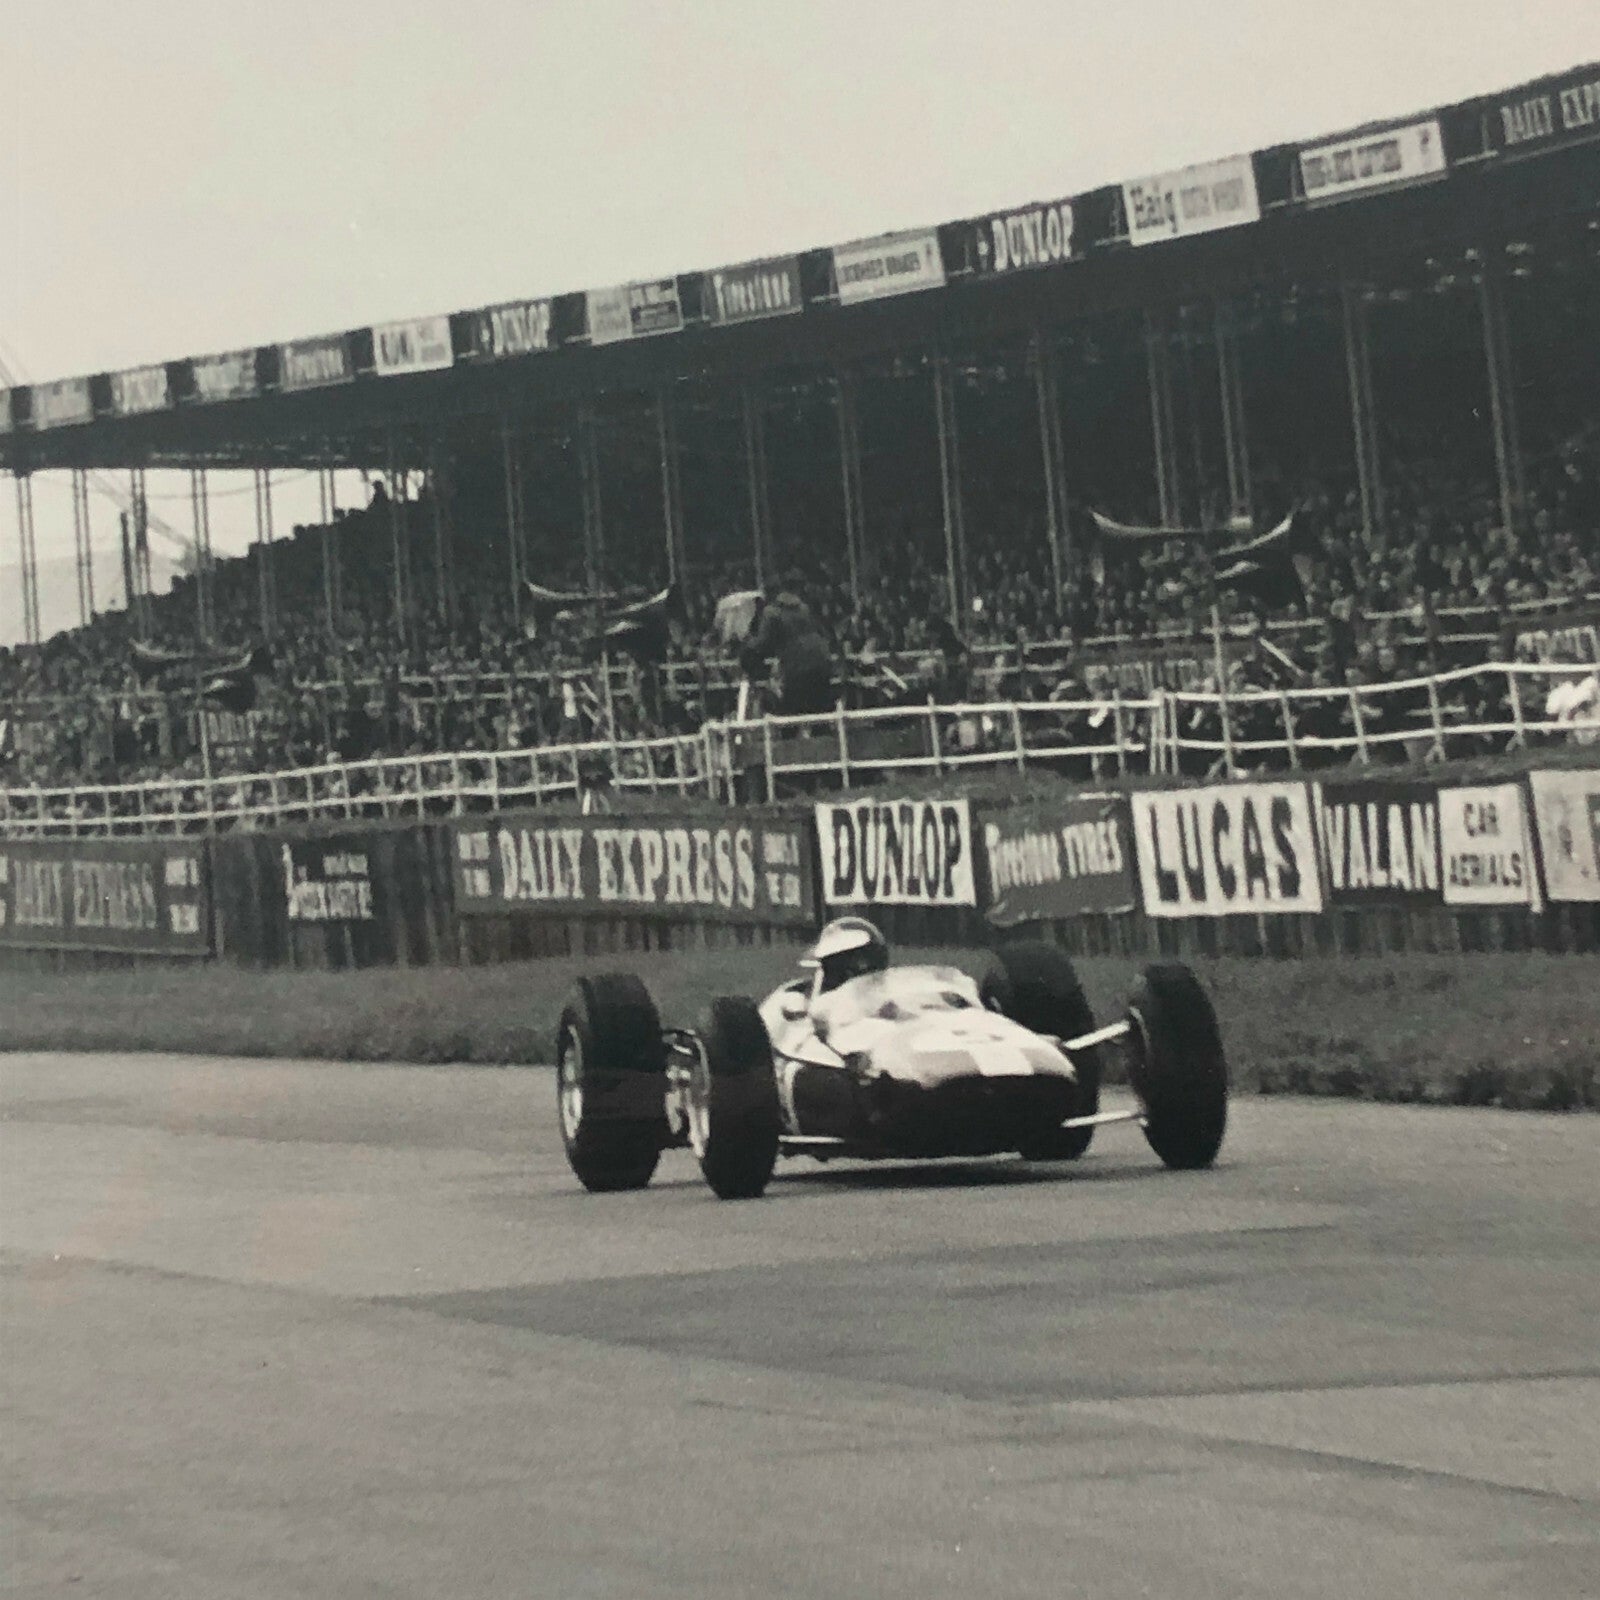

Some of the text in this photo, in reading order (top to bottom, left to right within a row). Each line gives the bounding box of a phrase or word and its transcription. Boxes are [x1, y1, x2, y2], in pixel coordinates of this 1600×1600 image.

[992, 204, 1074, 272] DUNLOP
[832, 805, 961, 900] DUNLOP
[1149, 796, 1301, 902] LUCAS
[1325, 802, 1439, 891] VALAN
[1464, 802, 1498, 837] CAR
[497, 829, 584, 899] DAILY
[593, 829, 755, 909] EXPRESS
